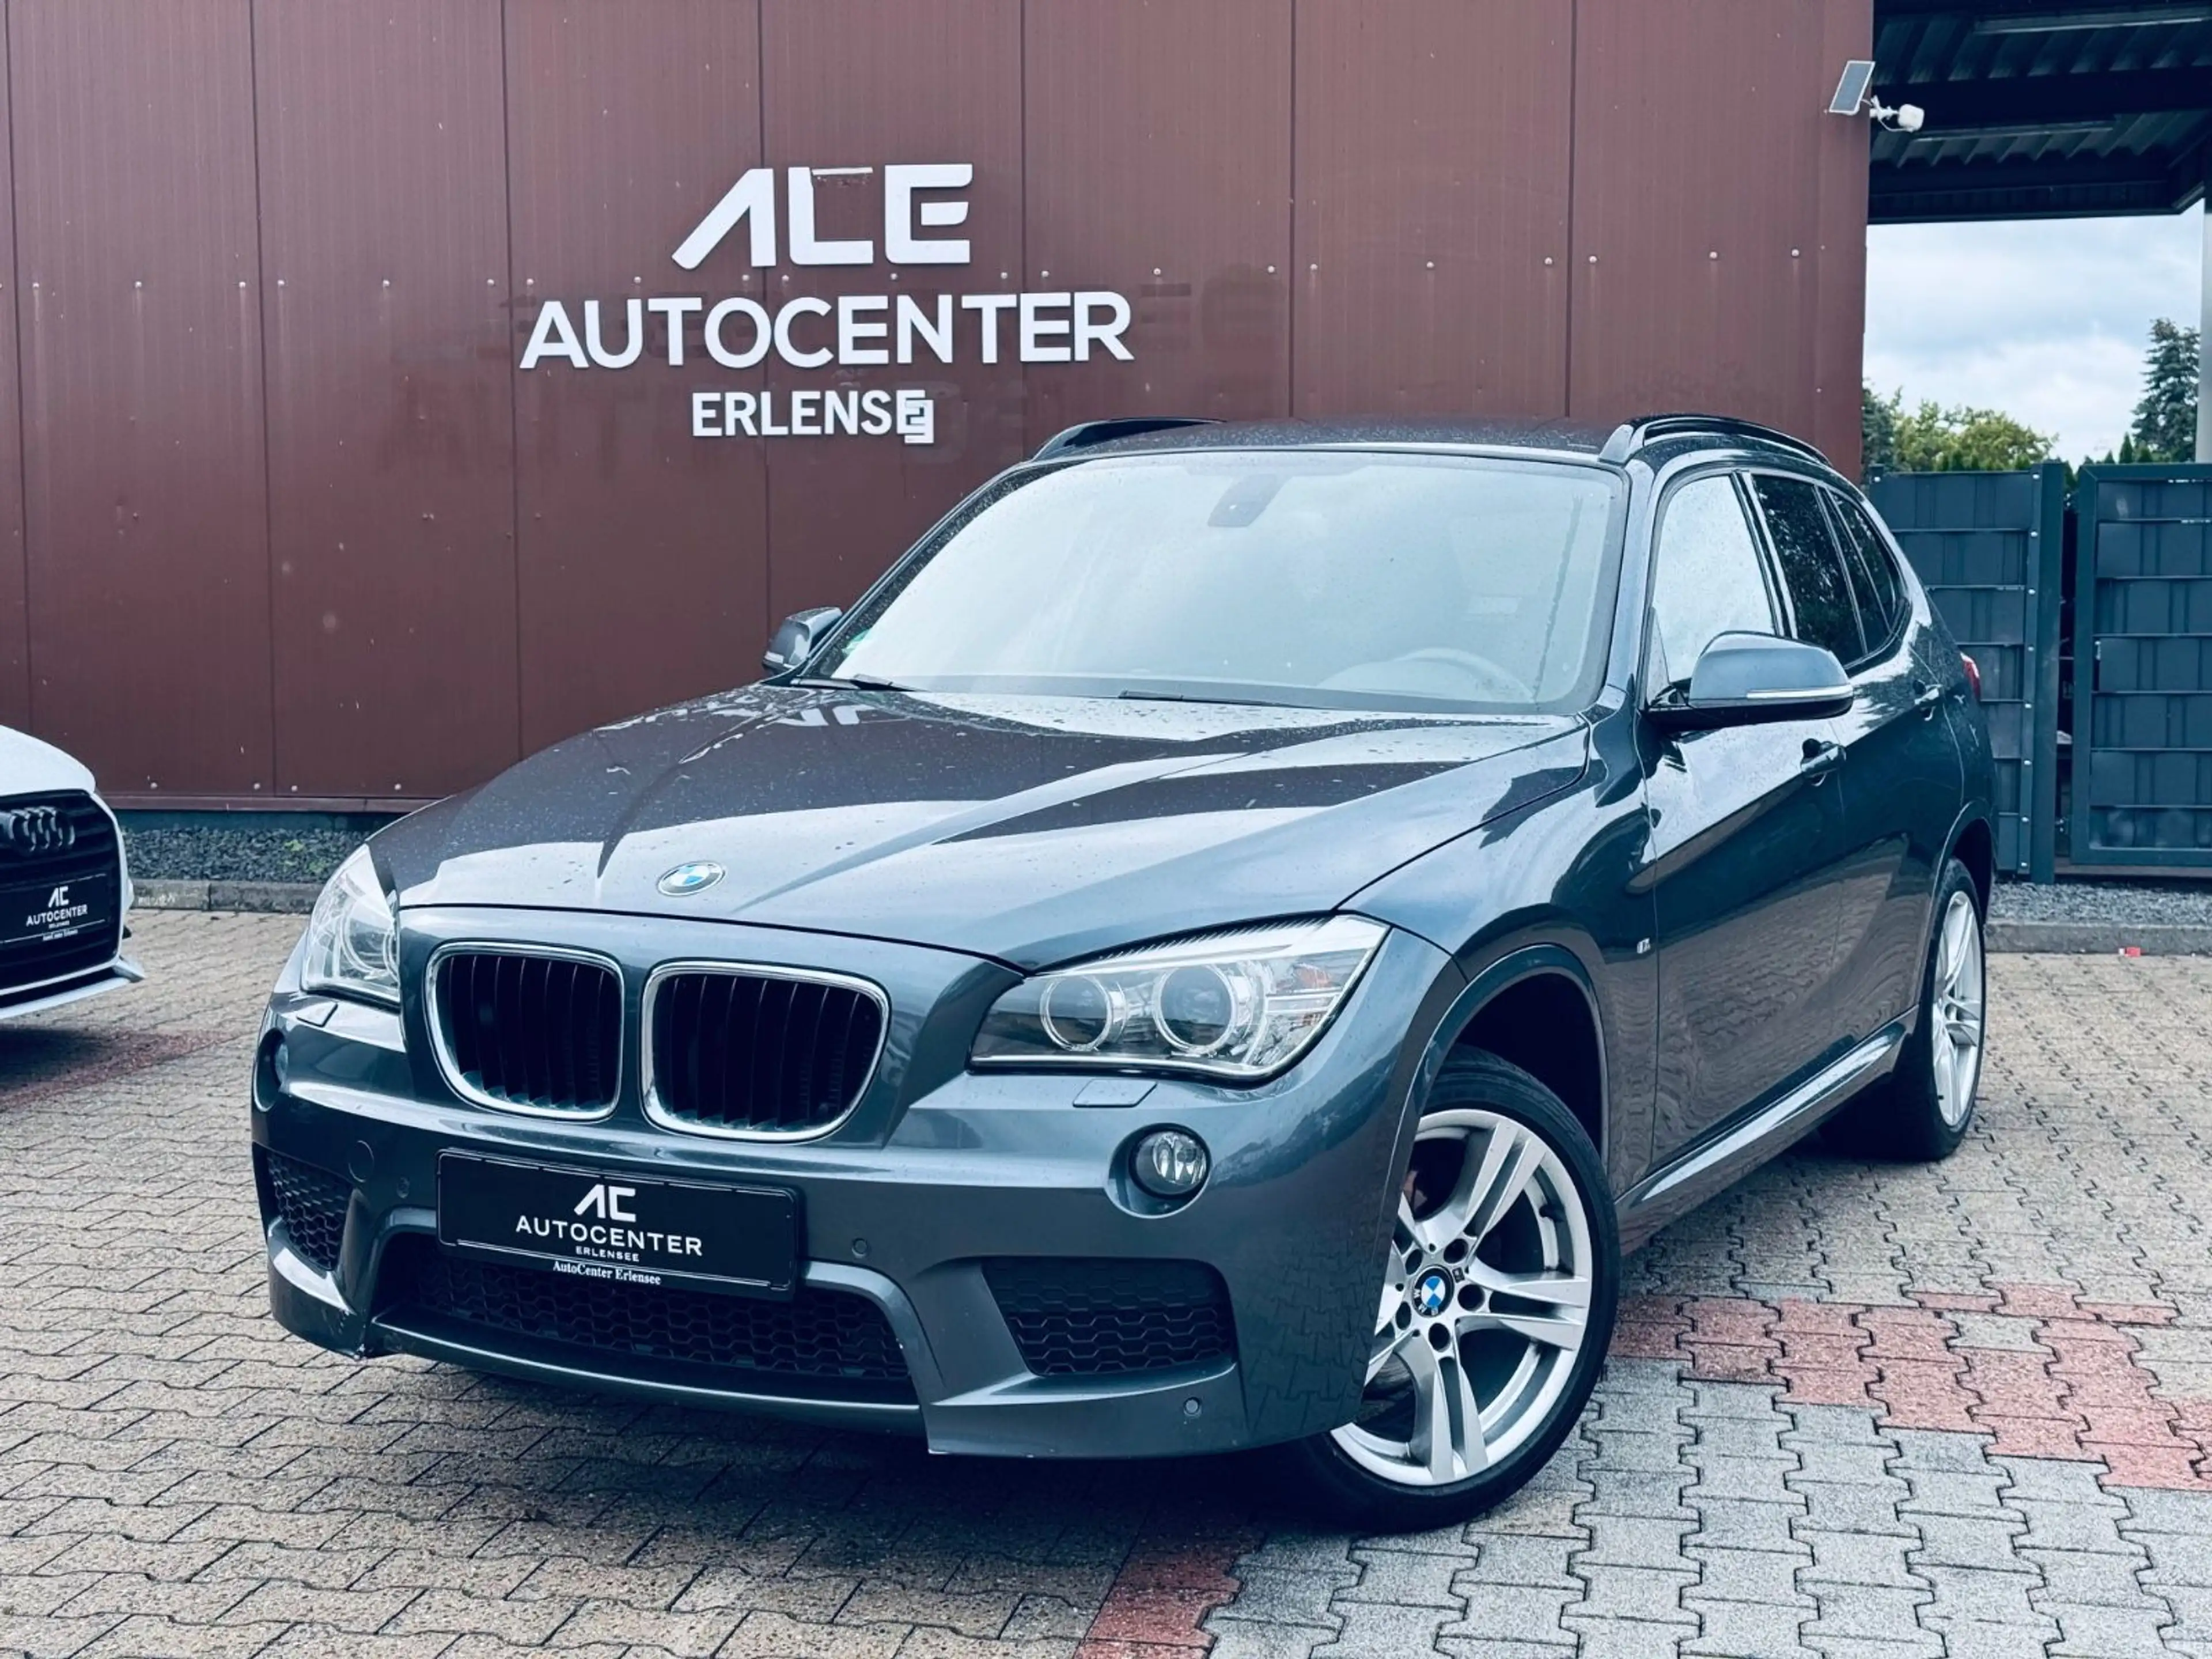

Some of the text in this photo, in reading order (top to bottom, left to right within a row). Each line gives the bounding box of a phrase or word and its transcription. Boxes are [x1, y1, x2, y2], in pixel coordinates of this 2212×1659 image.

[520, 291, 1135, 369] AUTOCENTER
[26, 904, 88, 927] AUTOCENTER
[574, 1184, 636, 1222] AC
[516, 1215, 703, 1256] AUTOCENTER
[576, 1245, 640, 1262] ERLENSEE
[552, 1260, 661, 1285] AutoCenter Erlensee
